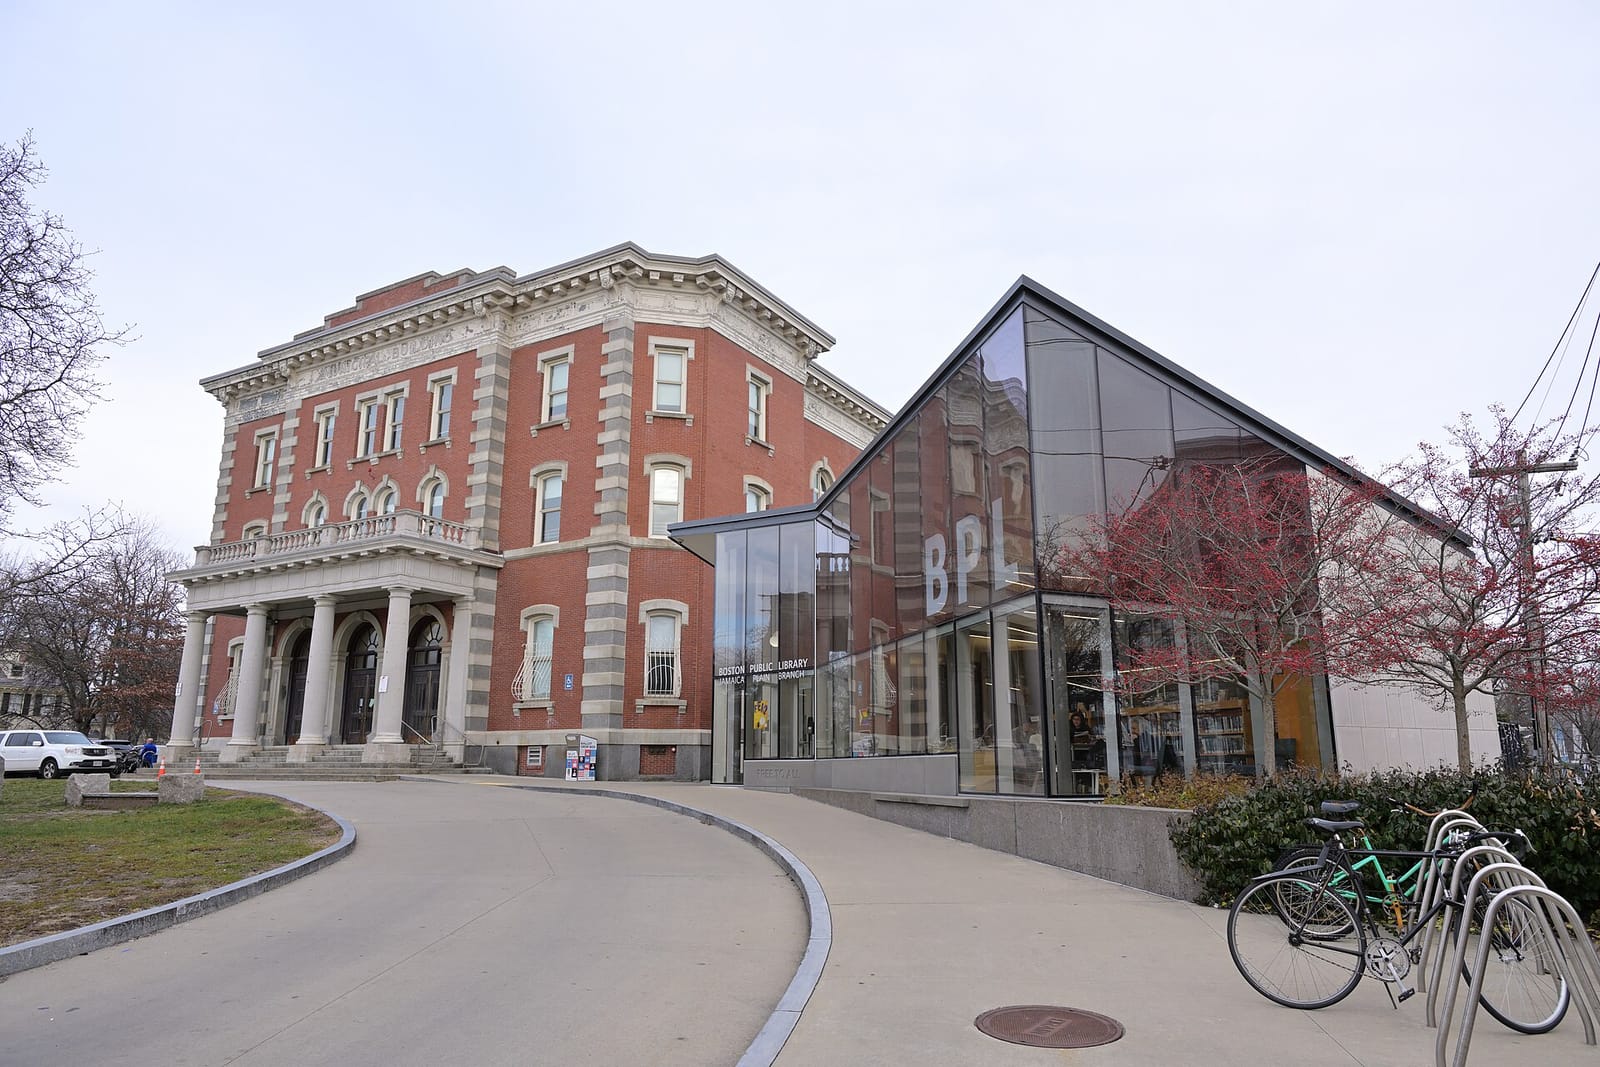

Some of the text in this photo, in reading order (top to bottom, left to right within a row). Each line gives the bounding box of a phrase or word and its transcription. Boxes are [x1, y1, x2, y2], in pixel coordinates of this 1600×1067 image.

[925, 496, 1019, 617] BPL
[718, 658, 808, 676] BOSTON PUBLIC LIBRARY
[719, 676, 745, 685] JAMAICA
[778, 670, 805, 681] BRANCH
